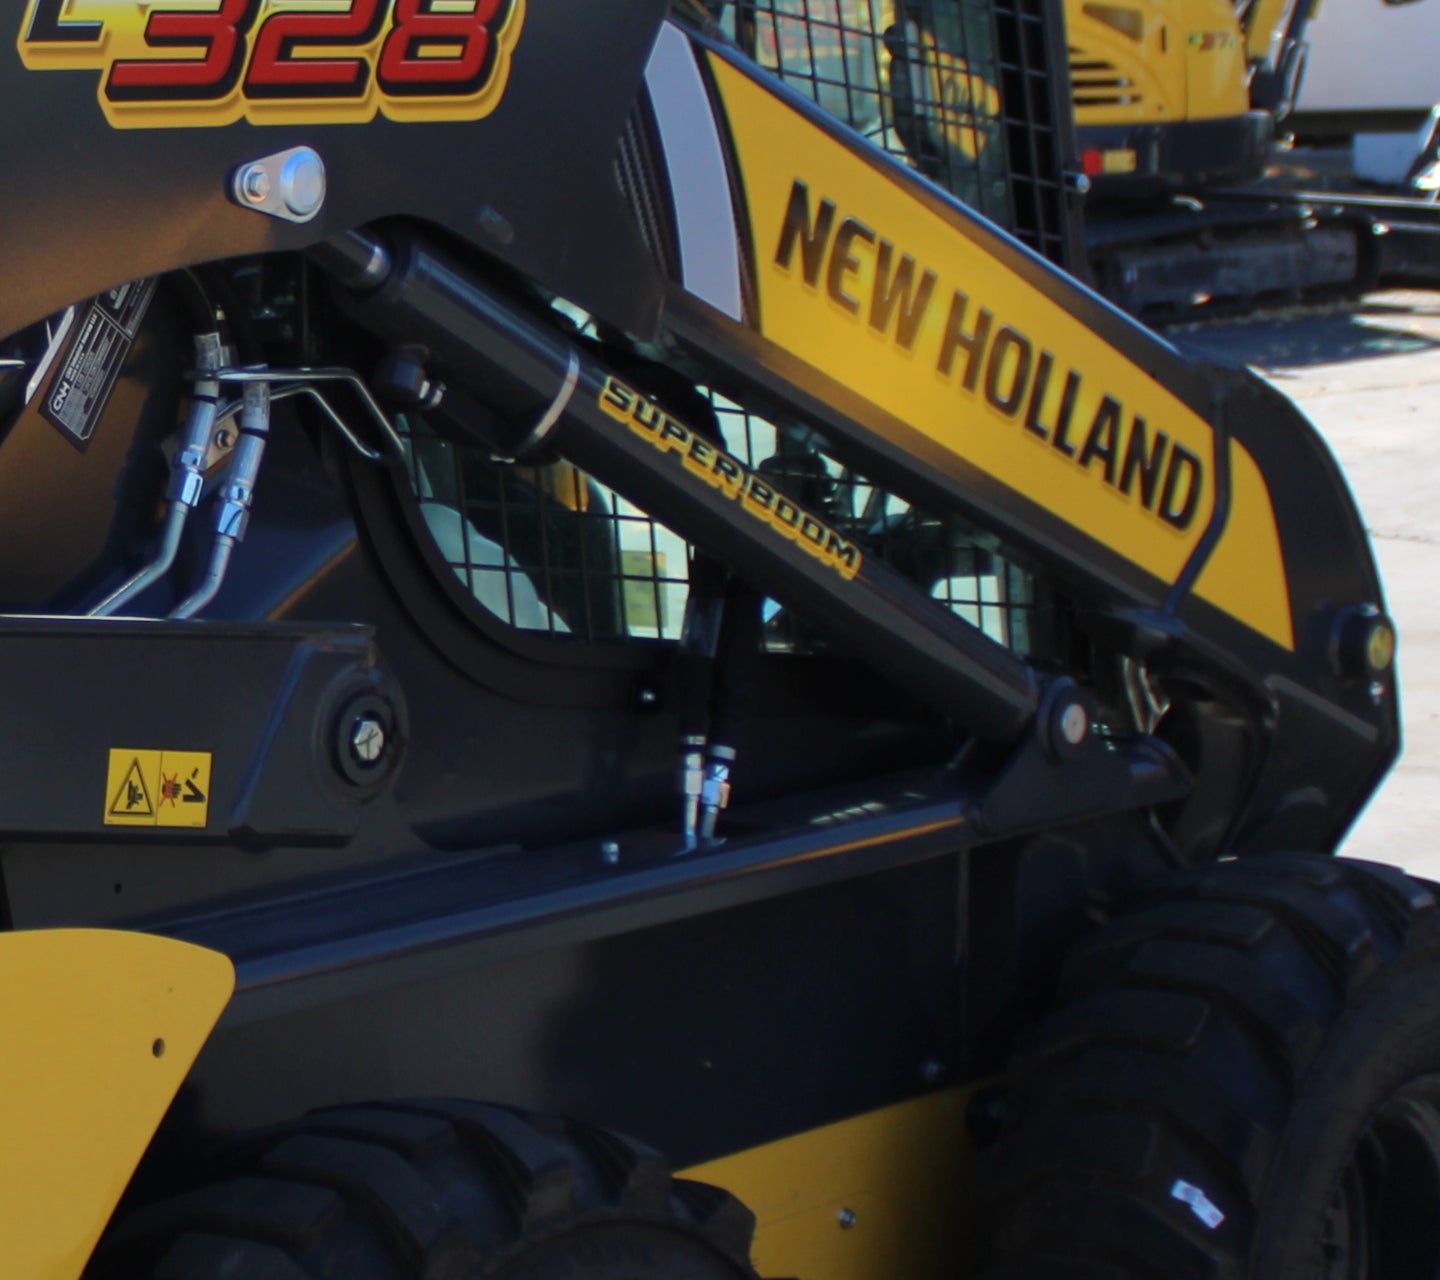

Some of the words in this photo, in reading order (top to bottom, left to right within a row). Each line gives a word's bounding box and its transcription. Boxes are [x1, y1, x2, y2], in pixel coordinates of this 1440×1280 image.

[602, 376, 744, 497] SUPER
[743, 473, 862, 580] BOOM
[773, 177, 938, 354] NEW
[936, 289, 1205, 532] HOLLAND
